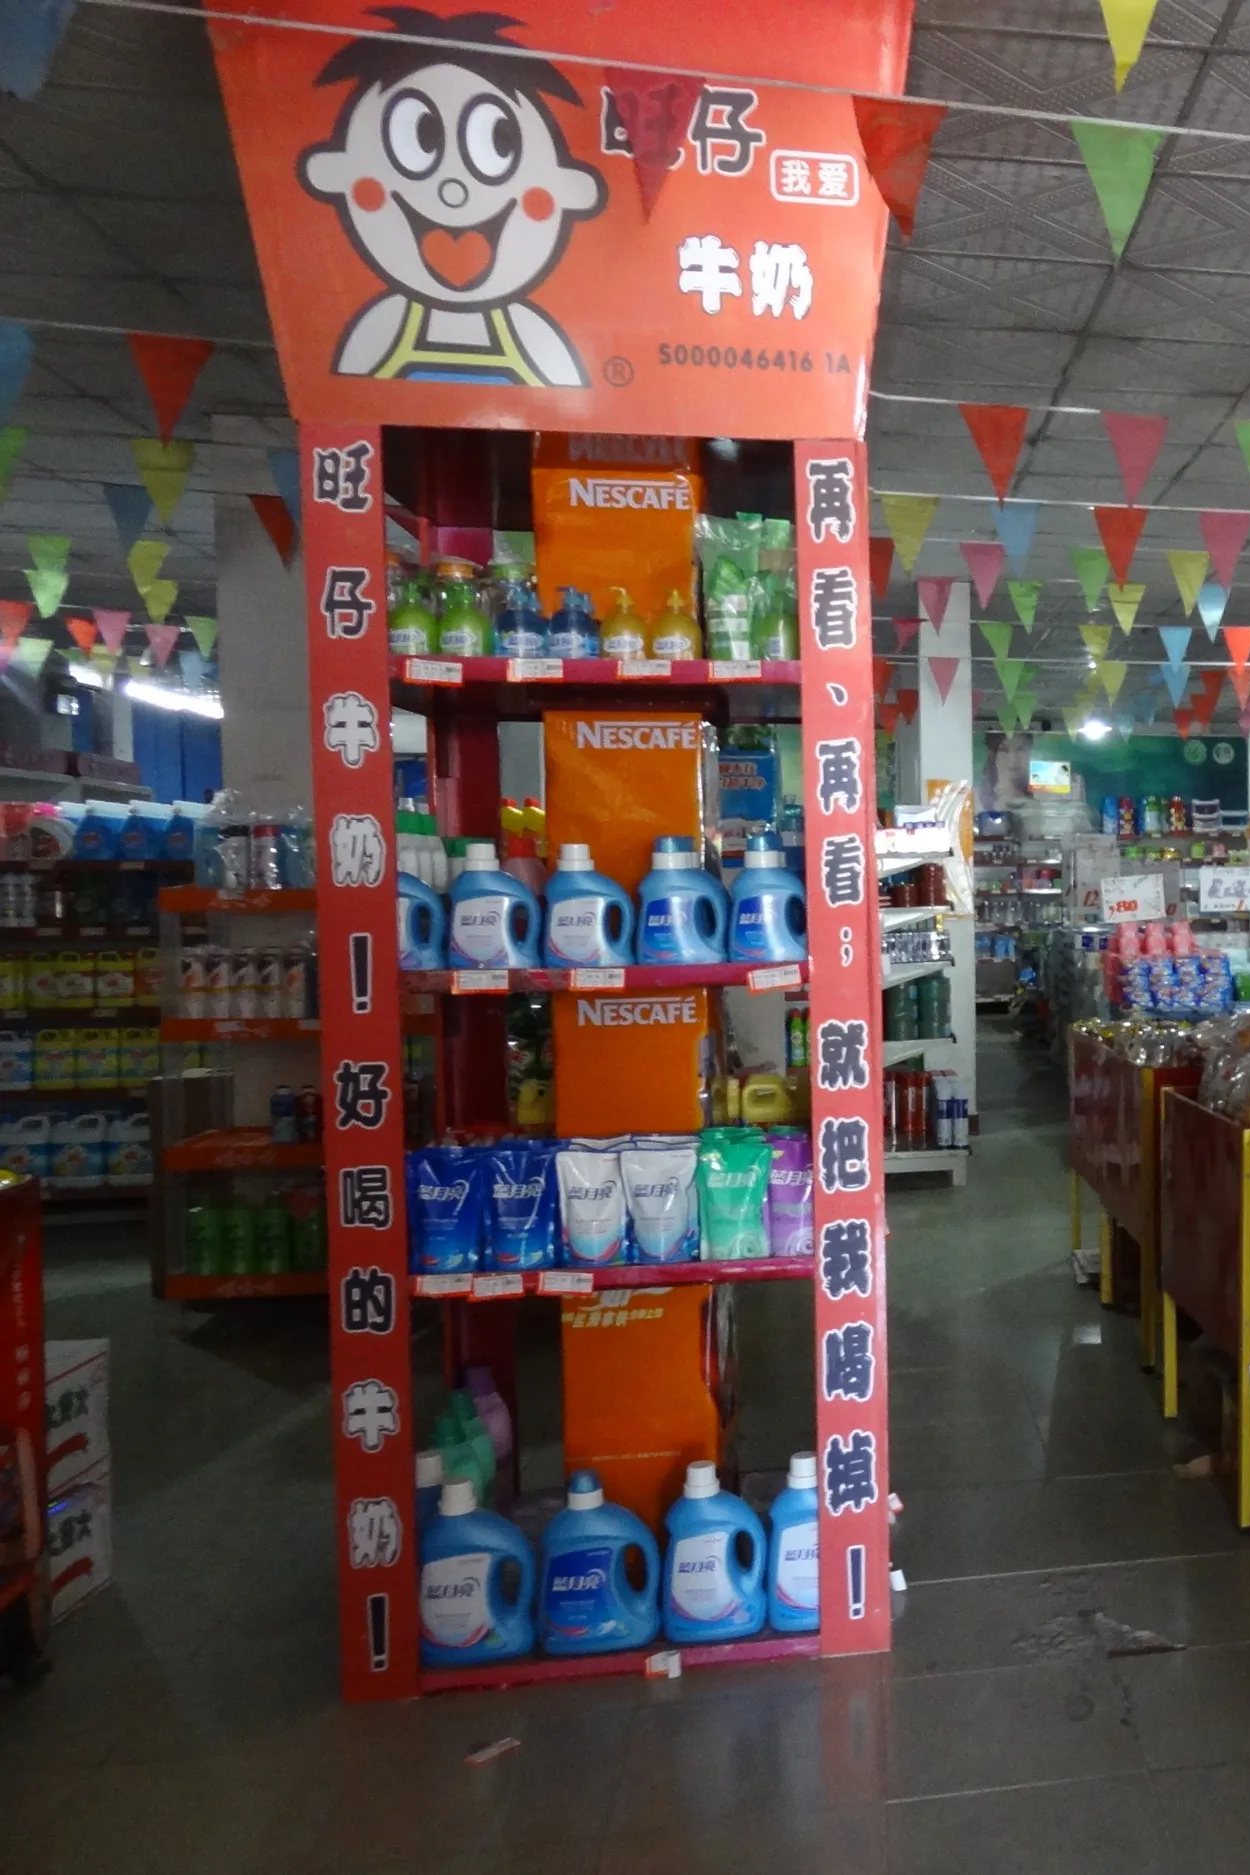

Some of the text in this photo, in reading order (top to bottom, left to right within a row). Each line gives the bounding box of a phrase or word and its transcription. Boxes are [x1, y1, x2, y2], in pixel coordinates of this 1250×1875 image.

[780, 158, 850, 199] 我爱
[677, 234, 816, 320] 牛奶
[657, 341, 852, 374] S000046416 1A
